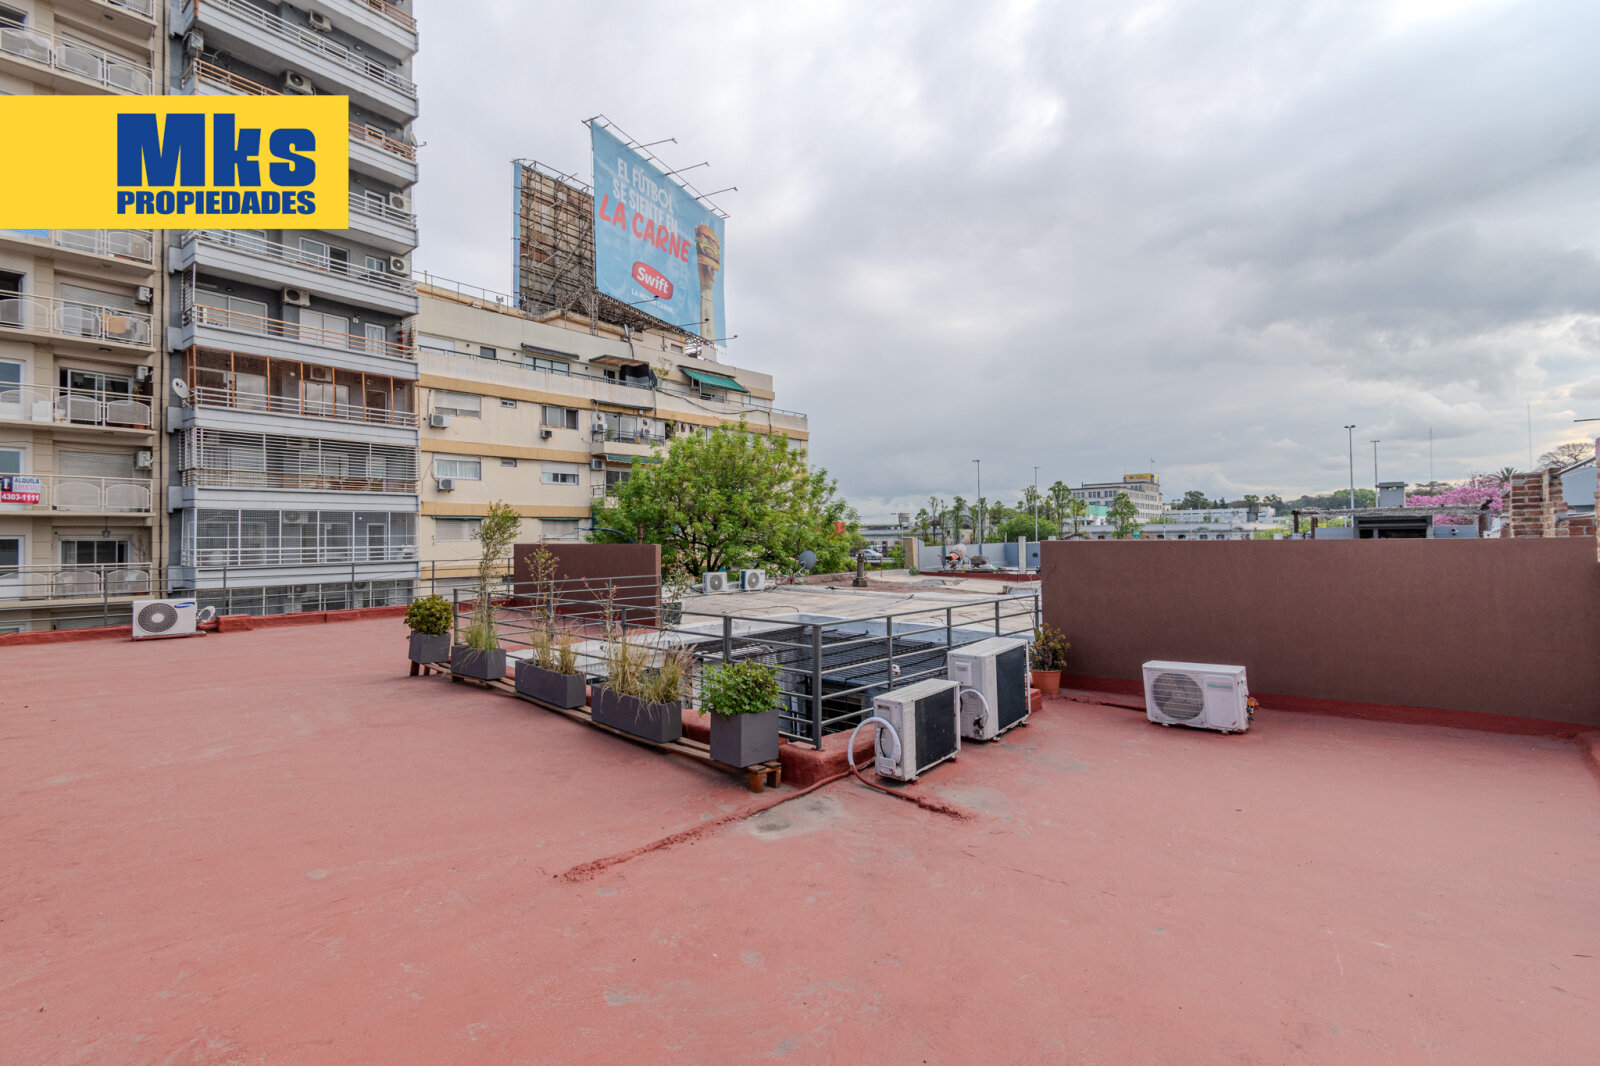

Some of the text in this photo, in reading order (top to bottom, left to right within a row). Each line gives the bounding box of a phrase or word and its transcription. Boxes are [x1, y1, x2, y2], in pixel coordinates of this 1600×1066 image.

[613, 178, 678, 237] SE SIENTE EN
[617, 157, 674, 214] EL FÚTBOL
[599, 193, 691, 263] LA CARNE
[637, 266, 669, 294] Swift
[2, 493, 39, 501] 4303-1111
